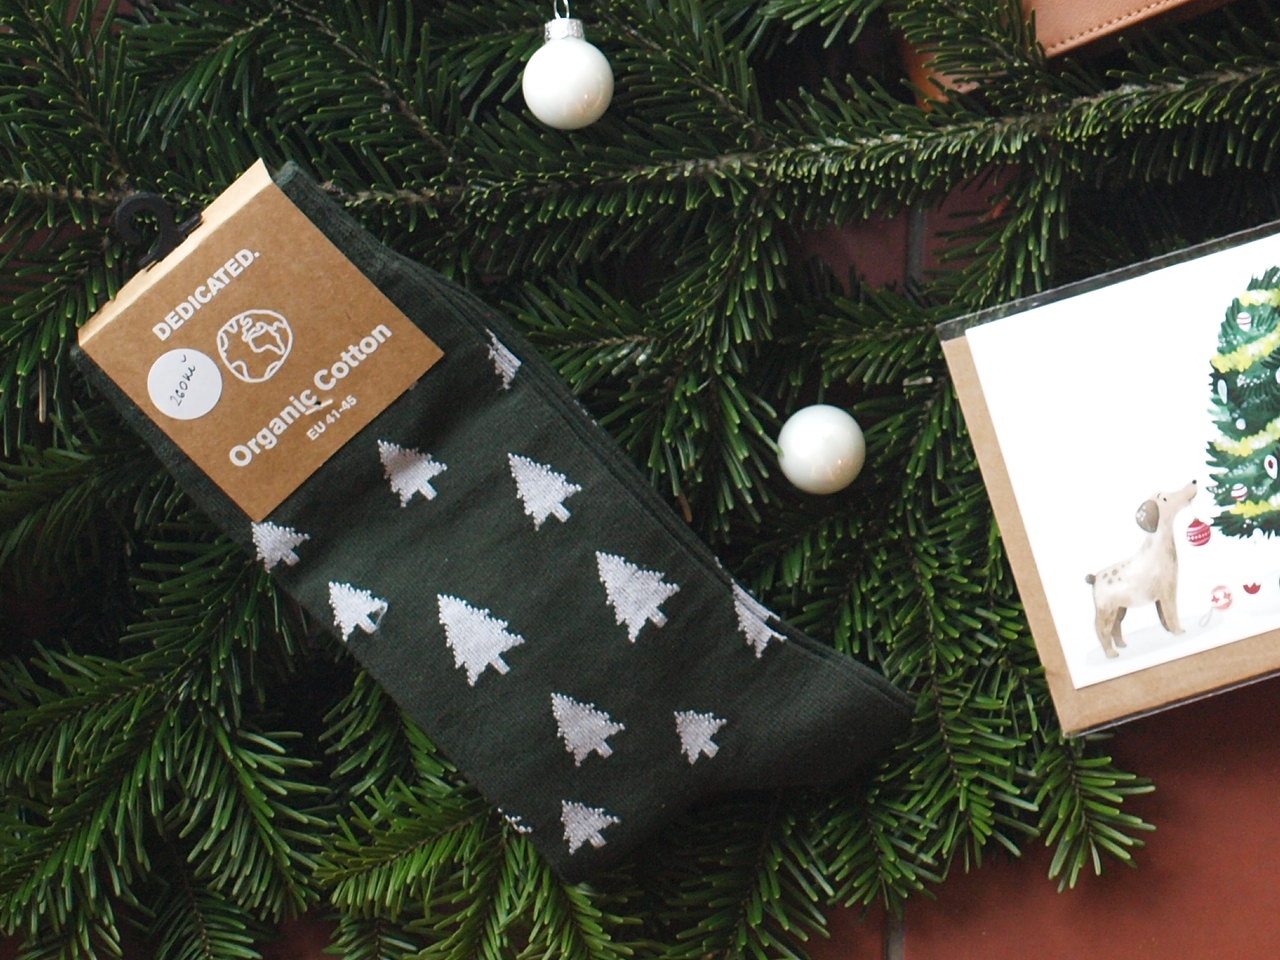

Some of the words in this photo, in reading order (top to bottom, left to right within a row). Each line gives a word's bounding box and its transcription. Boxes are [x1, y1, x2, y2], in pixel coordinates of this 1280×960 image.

[152, 248, 260, 341] DEDICATED.
[229, 389, 318, 467] Organic
[314, 324, 393, 391] Cotton
[306, 420, 326, 441] EU
[326, 395, 357, 425] 41-45
